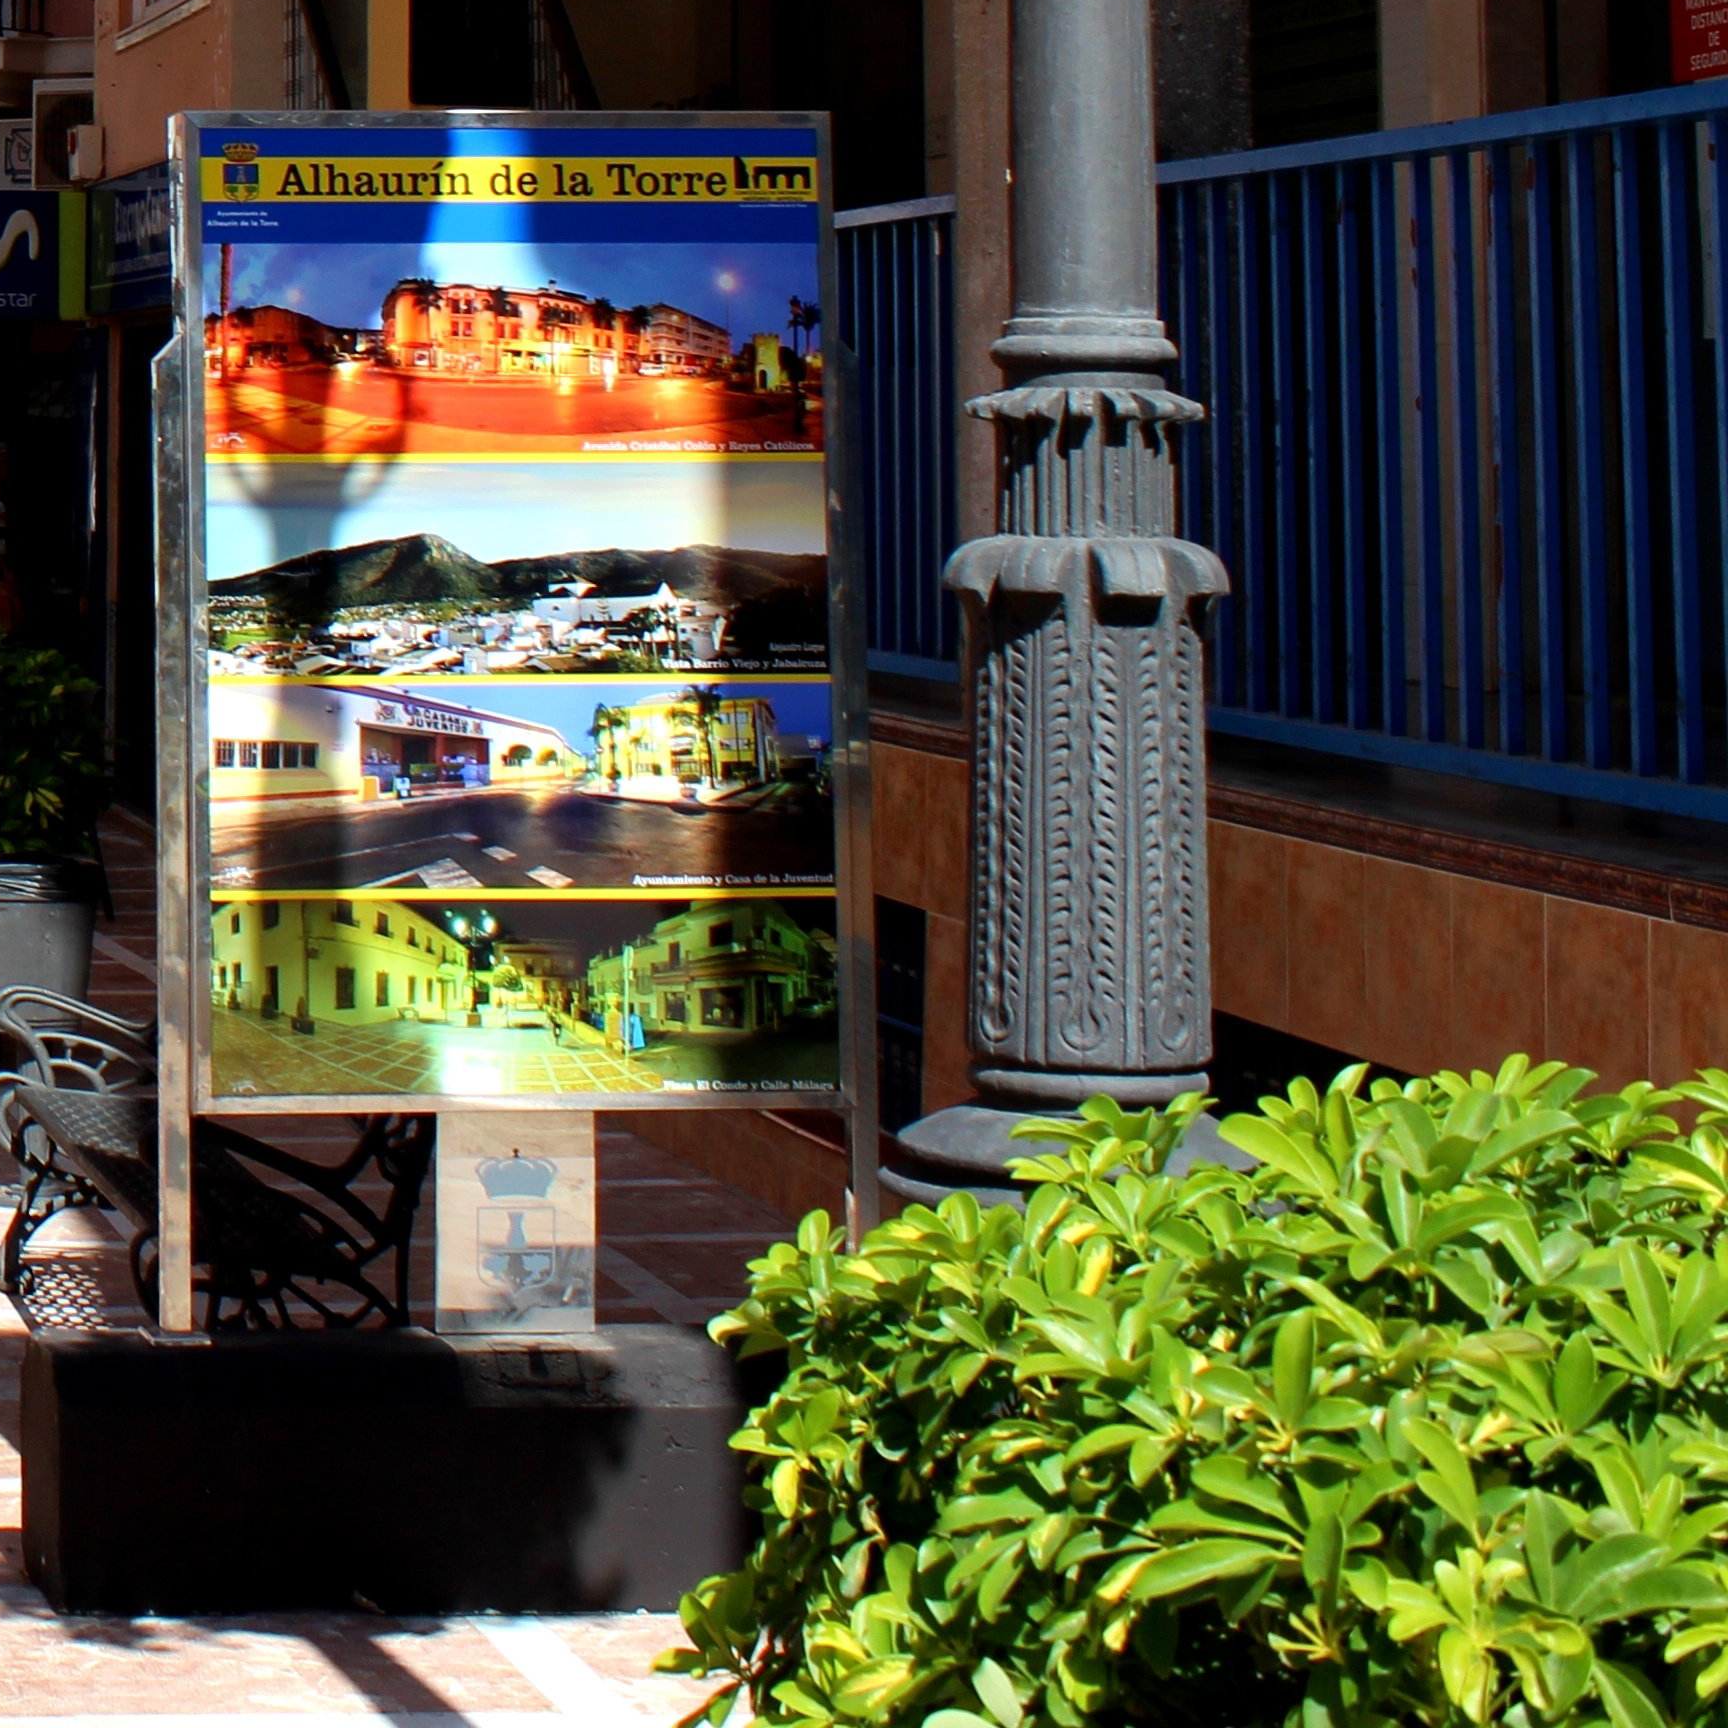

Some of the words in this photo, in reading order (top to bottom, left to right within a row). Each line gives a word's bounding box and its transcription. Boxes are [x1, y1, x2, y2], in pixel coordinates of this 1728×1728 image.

[1708, 30, 1721, 47] DE
[276, 161, 473, 196] Alhaurín
[489, 164, 539, 196] de
[552, 163, 593, 196] la
[606, 163, 728, 196] Torre
[683, 440, 716, 451] Colón
[729, 441, 761, 453] Reyes
[763, 440, 815, 451] Católicos
[660, 658, 692, 669] Vista
[694, 658, 729, 669] Barrio
[731, 658, 760, 669] Viejo
[763, 660, 769, 670] y
[632, 874, 713, 887] Ayuntamiento
[715, 876, 722, 886] y
[725, 874, 752, 884] Casa
[753, 874, 767, 883] de
[770, 874, 781, 883] la
[783, 873, 833, 883] Juventud
[696, 1079, 710, 1091] El
[712, 1079, 748, 1091] Conde
[750, 1082, 757, 1092] y
[761, 1079, 790, 1091] Calle
